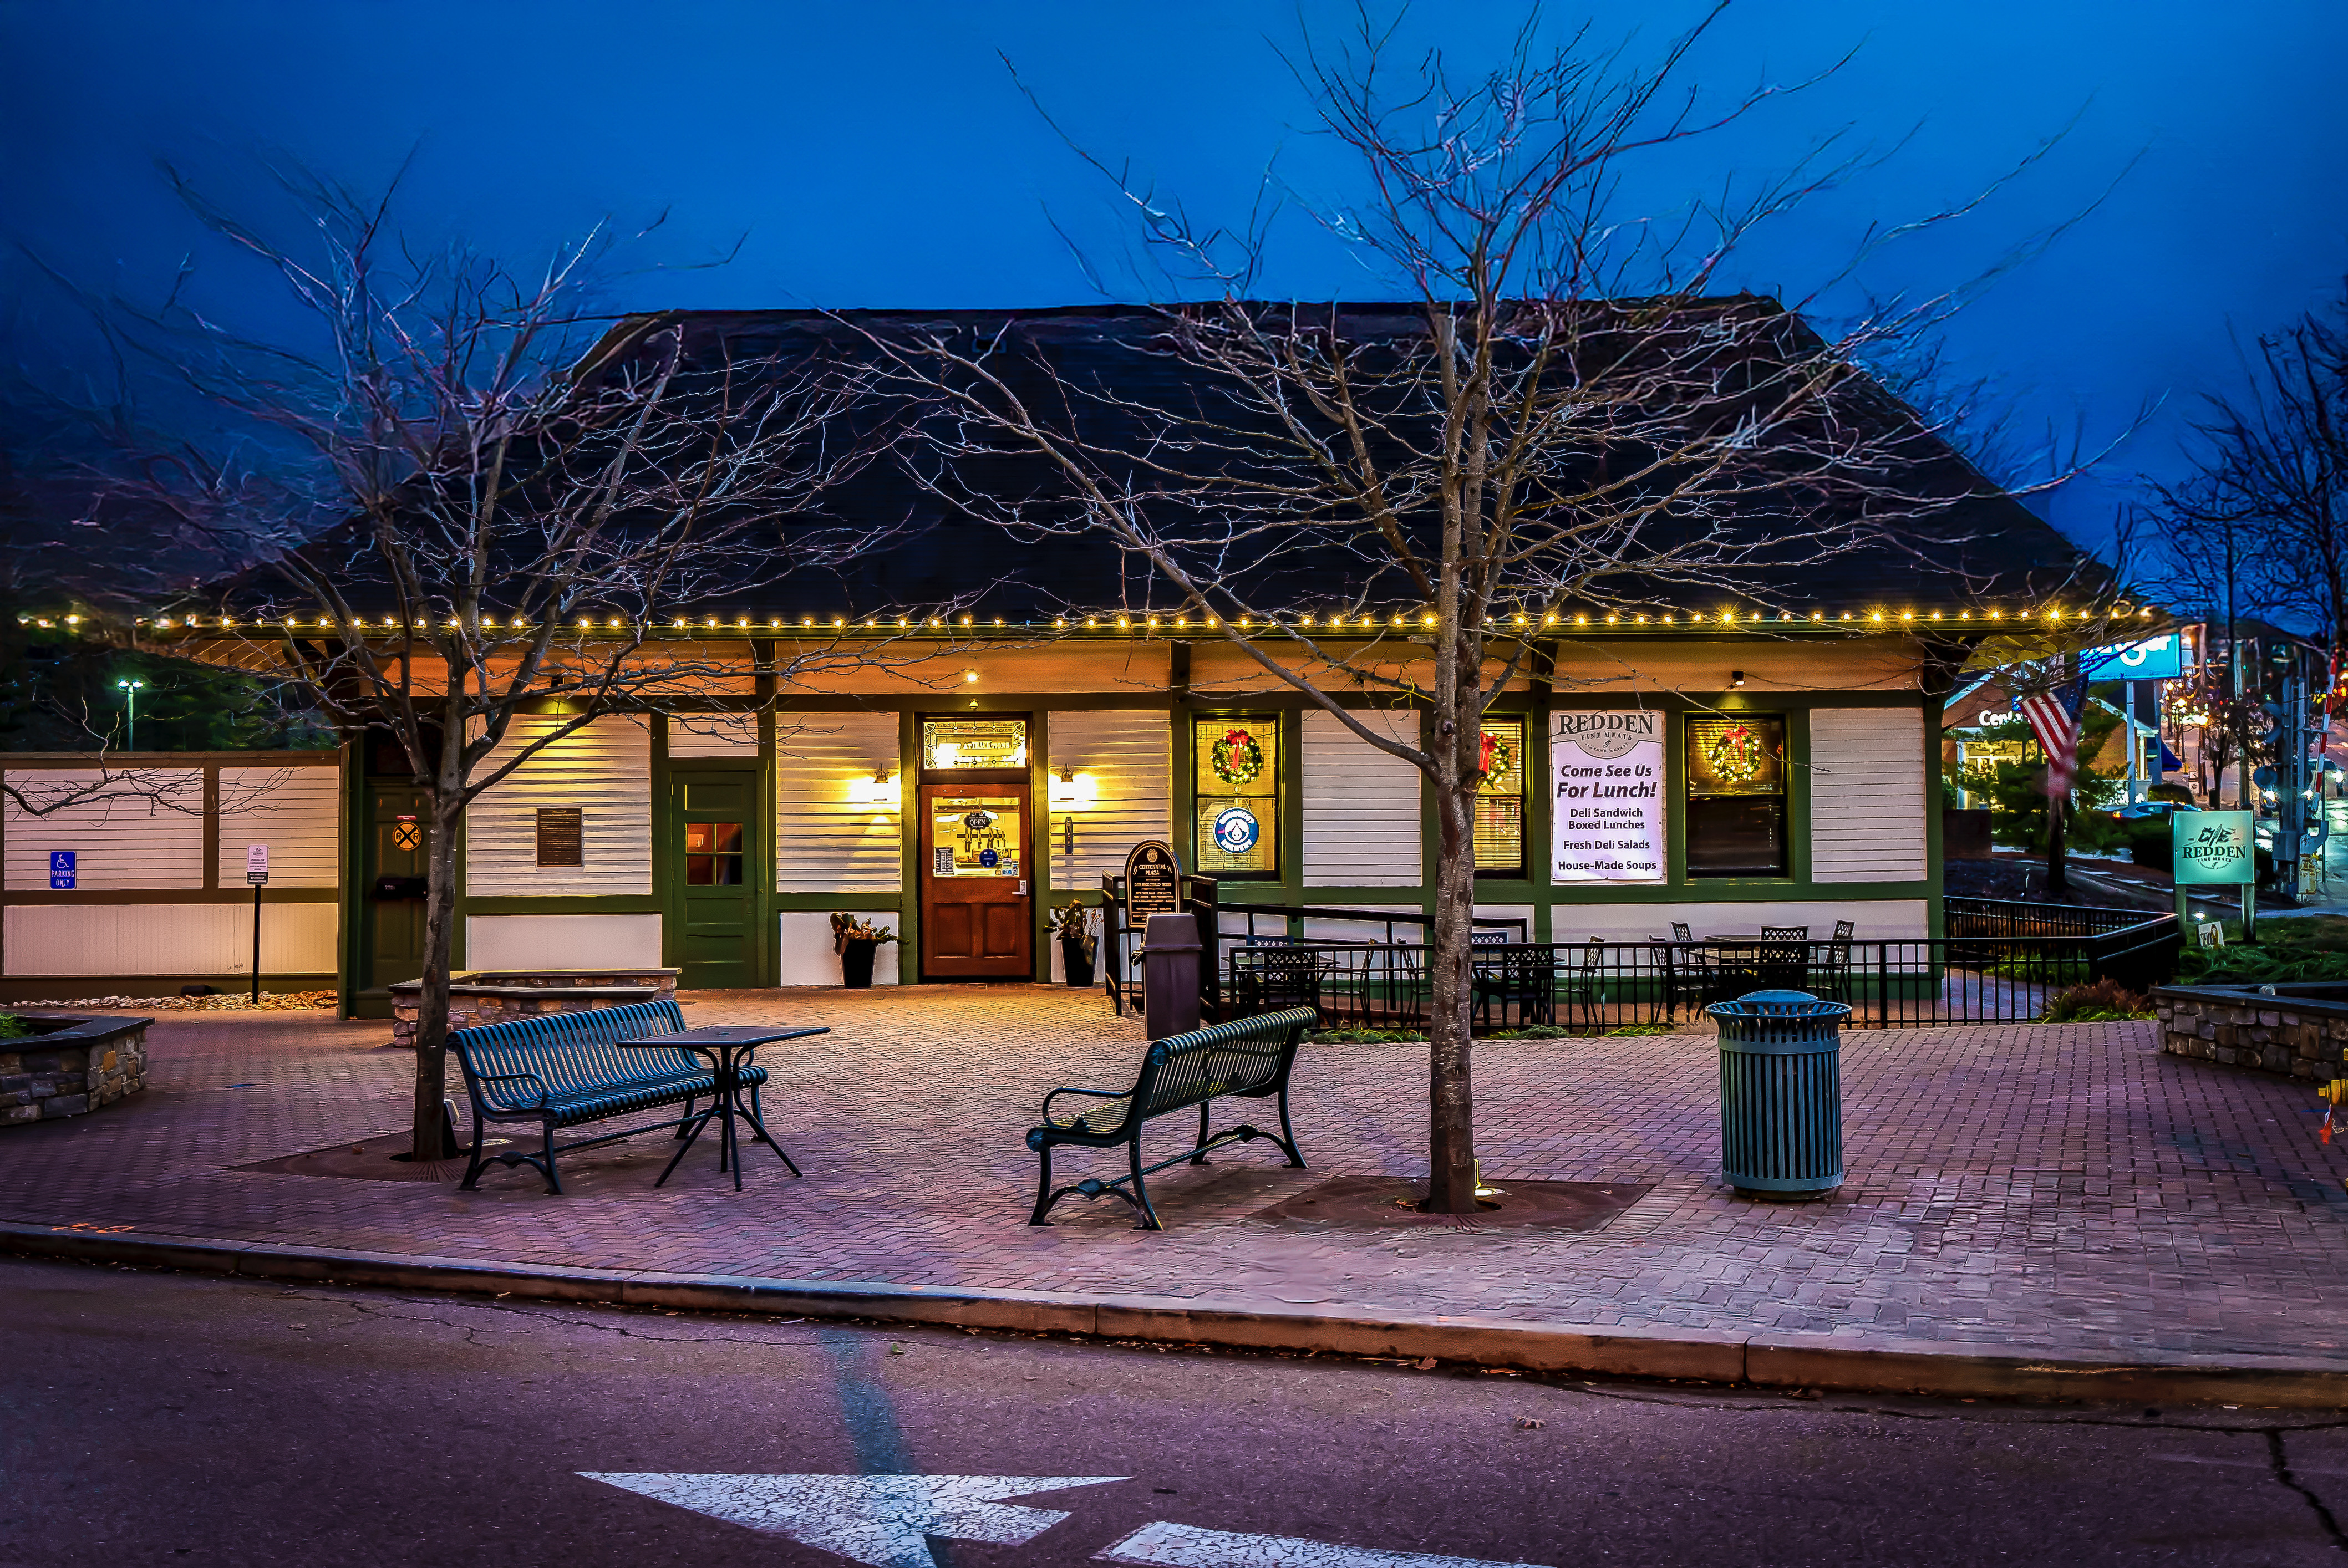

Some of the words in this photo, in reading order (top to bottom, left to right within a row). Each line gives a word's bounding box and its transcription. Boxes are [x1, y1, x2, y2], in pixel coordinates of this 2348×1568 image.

[1559, 714, 1656, 734] REDDEN
[1581, 732, 1601, 741] FINE
[1561, 765, 1603, 777] Come
[1605, 765, 1631, 777] See
[1635, 765, 1652, 777] Us
[1557, 782, 1589, 798] For
[1593, 781, 1658, 798] Lunch!
[1571, 808, 1591, 817] Deli
[1593, 808, 1643, 817] Sandwich
[1568, 820, 1601, 829] Boxed
[1604, 820, 1645, 829] Lunches
[1564, 841, 1592, 849] Fresh
[1594, 840, 1615, 849] Deli
[1618, 840, 1650, 849] Salads
[2182, 846, 2246, 858] REDDEN
[1558, 861, 1623, 870] House-Made
[1626, 861, 1656, 871] Soups
